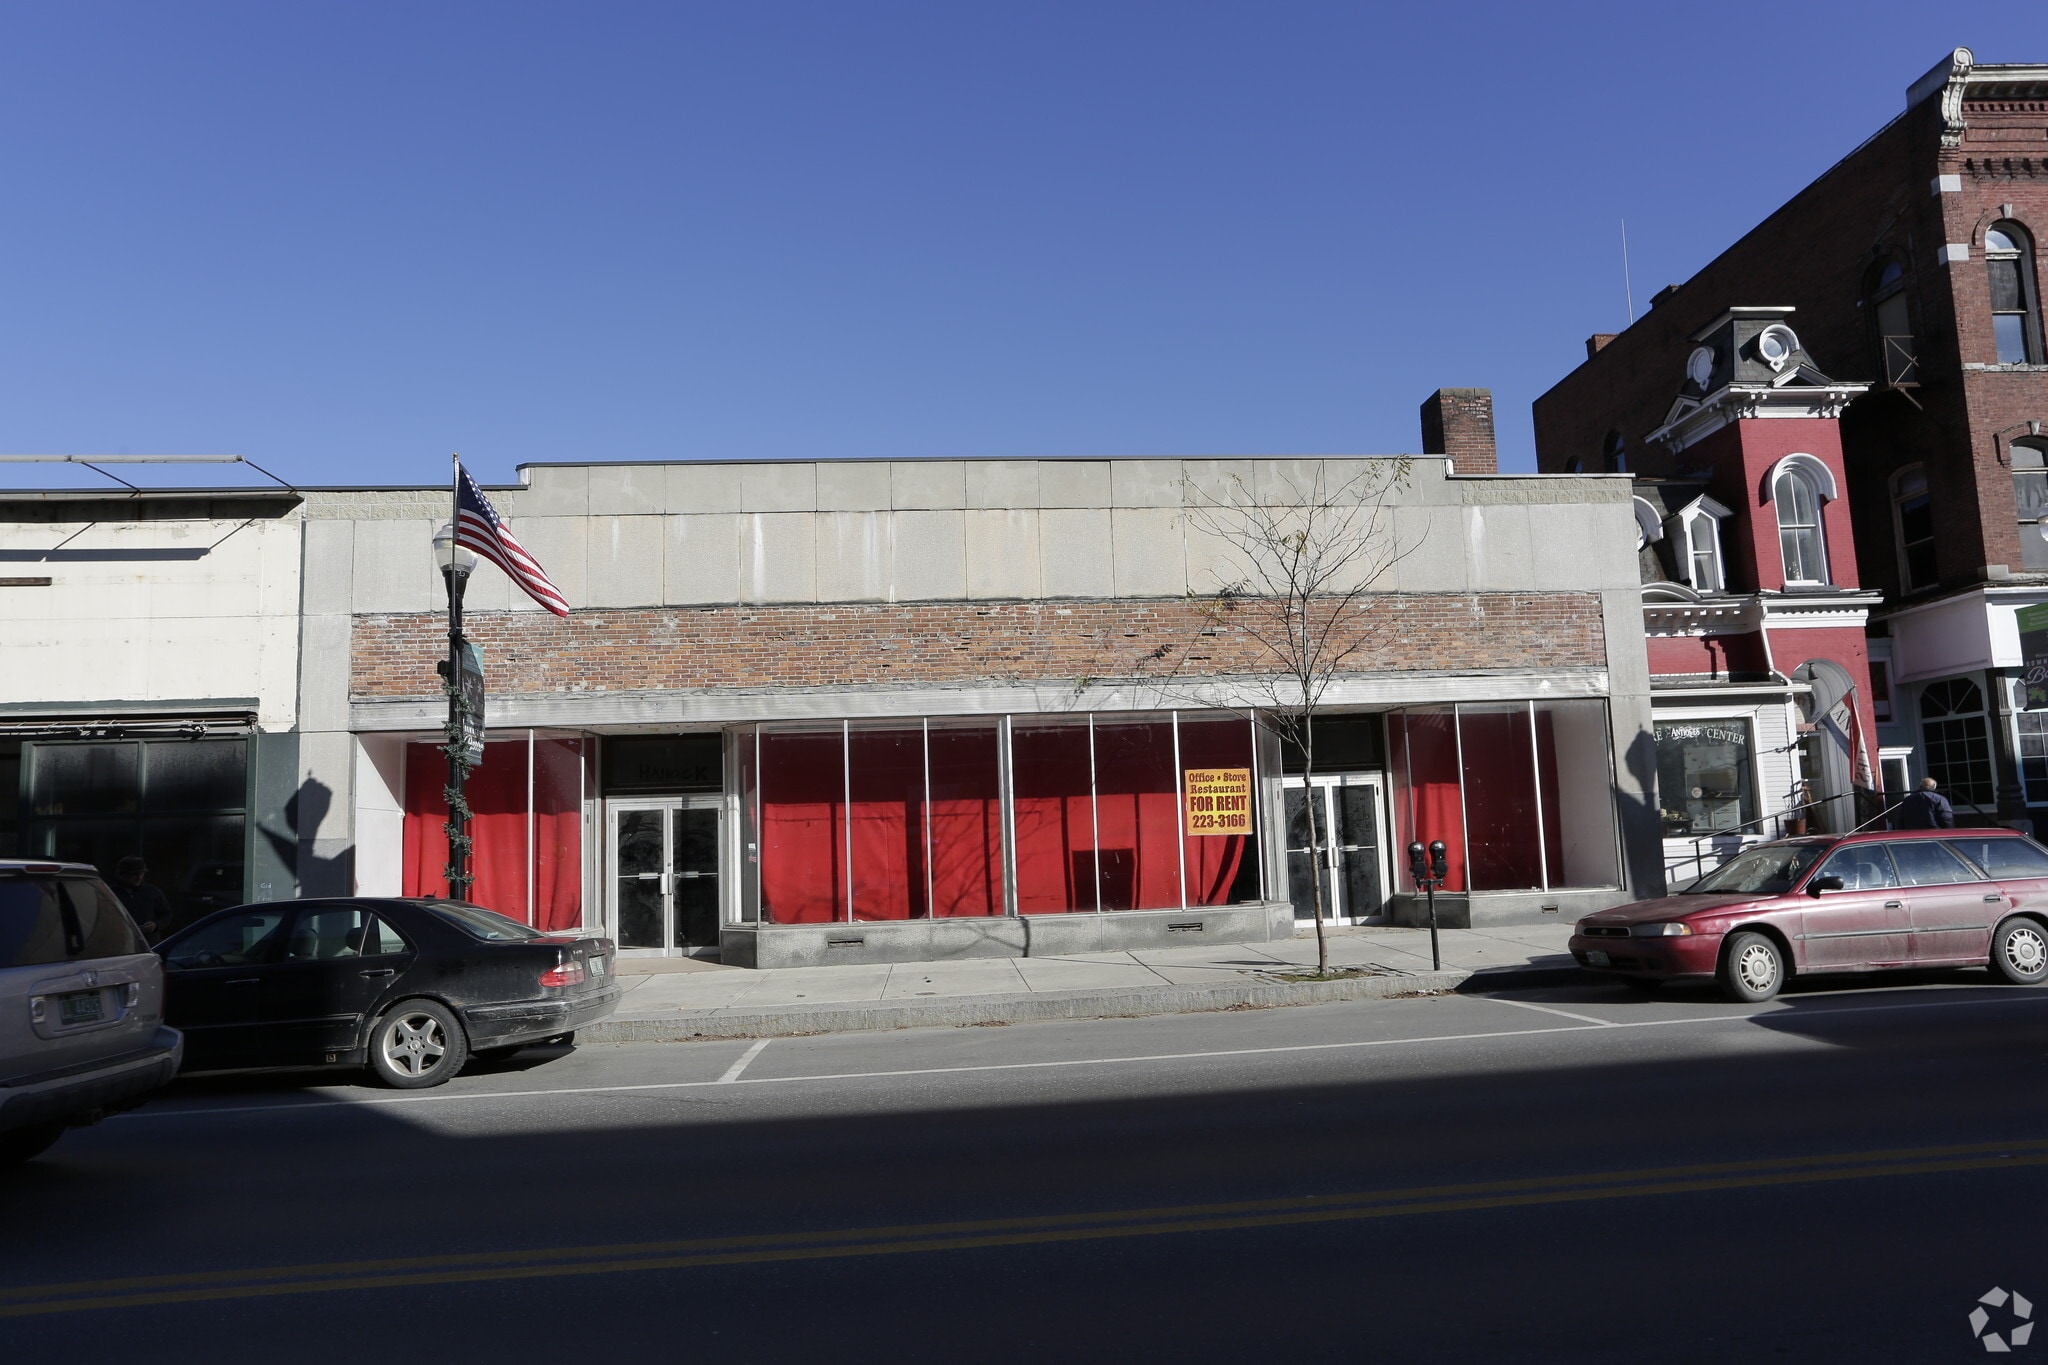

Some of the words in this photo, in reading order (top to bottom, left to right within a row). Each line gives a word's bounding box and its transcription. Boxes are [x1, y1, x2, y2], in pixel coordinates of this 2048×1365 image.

[1706, 728, 1745, 745] CENTER
[1188, 772, 1215, 783] Office
[1223, 772, 1247, 782] Store
[1189, 783, 1247, 794] Restaurant
[1189, 796, 1214, 812] FOR
[1216, 795, 1247, 811] RENT
[1192, 813, 1246, 829] 223-3166
